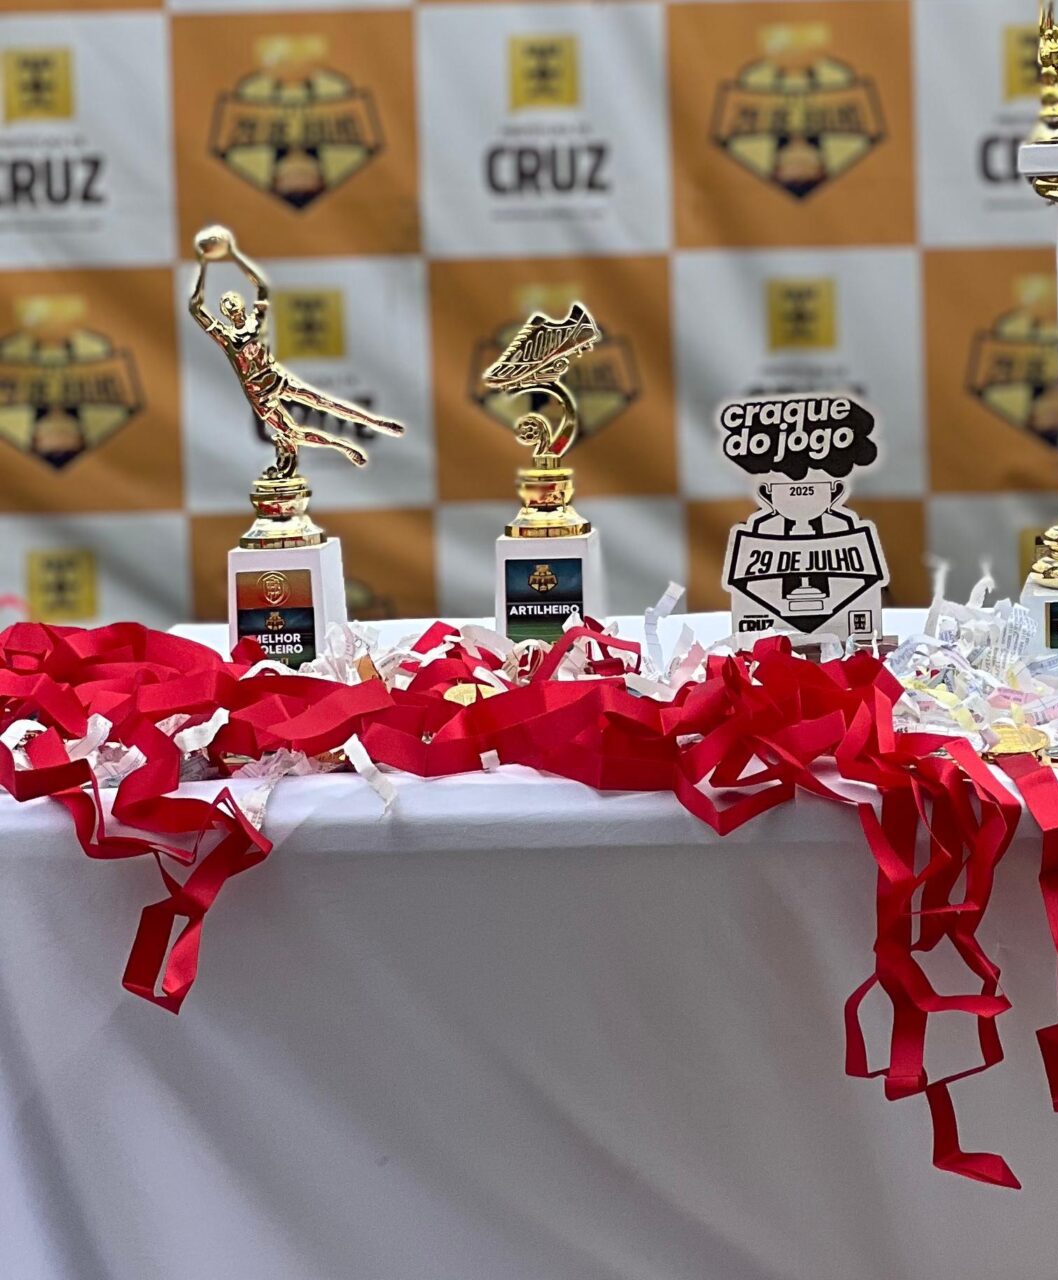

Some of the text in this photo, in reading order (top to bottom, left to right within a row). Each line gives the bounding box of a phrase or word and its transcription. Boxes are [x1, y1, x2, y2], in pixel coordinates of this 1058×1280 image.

[0, 155, 105, 207] RUZ
[484, 142, 610, 197] CRUZ
[723, 399, 851, 432] craque
[725, 422, 854, 462] do jogo
[789, 486, 815, 496] 2025
[745, 547, 865, 576] 29 DE JULHO
[509, 604, 580, 616] ARTILHEIRO
[260, 644, 303, 655] OLEIRO
